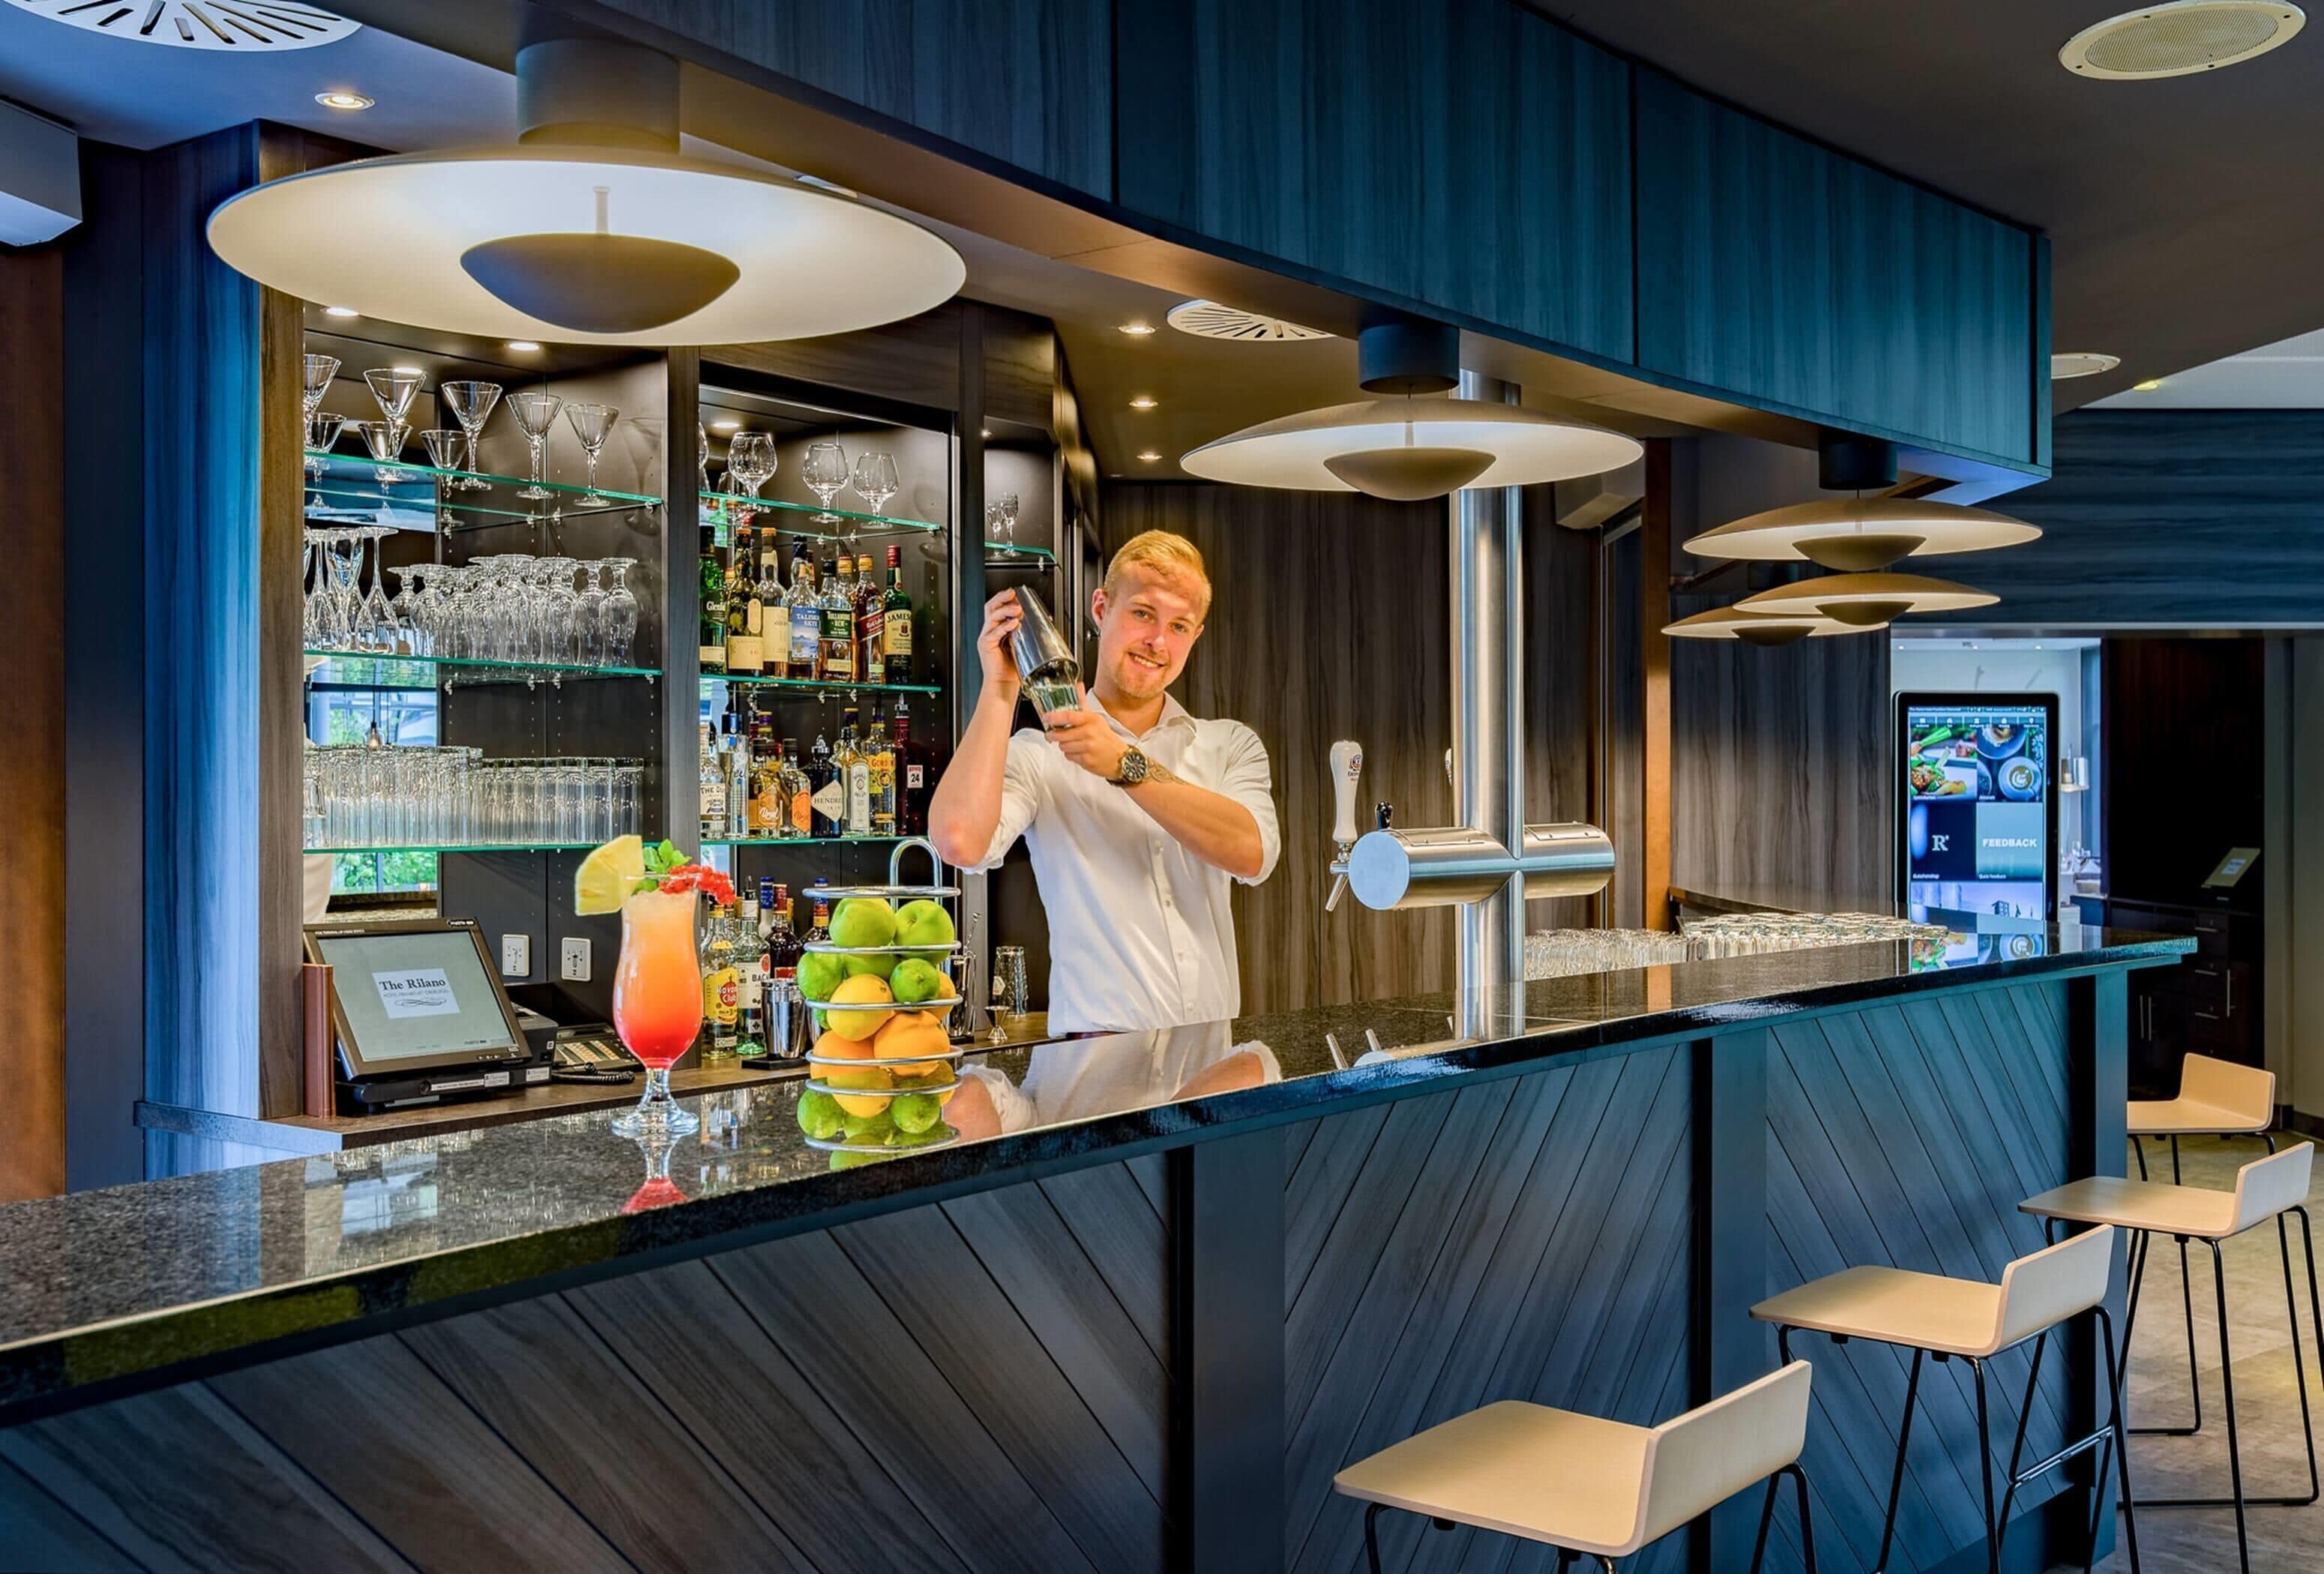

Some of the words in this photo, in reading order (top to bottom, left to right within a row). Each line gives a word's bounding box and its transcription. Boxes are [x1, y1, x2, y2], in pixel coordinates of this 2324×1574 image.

[911, 773, 921, 783] 24
[1982, 838, 2038, 848] FEEDBACK
[379, 980, 404, 990] The
[406, 978, 446, 989] Rilano
